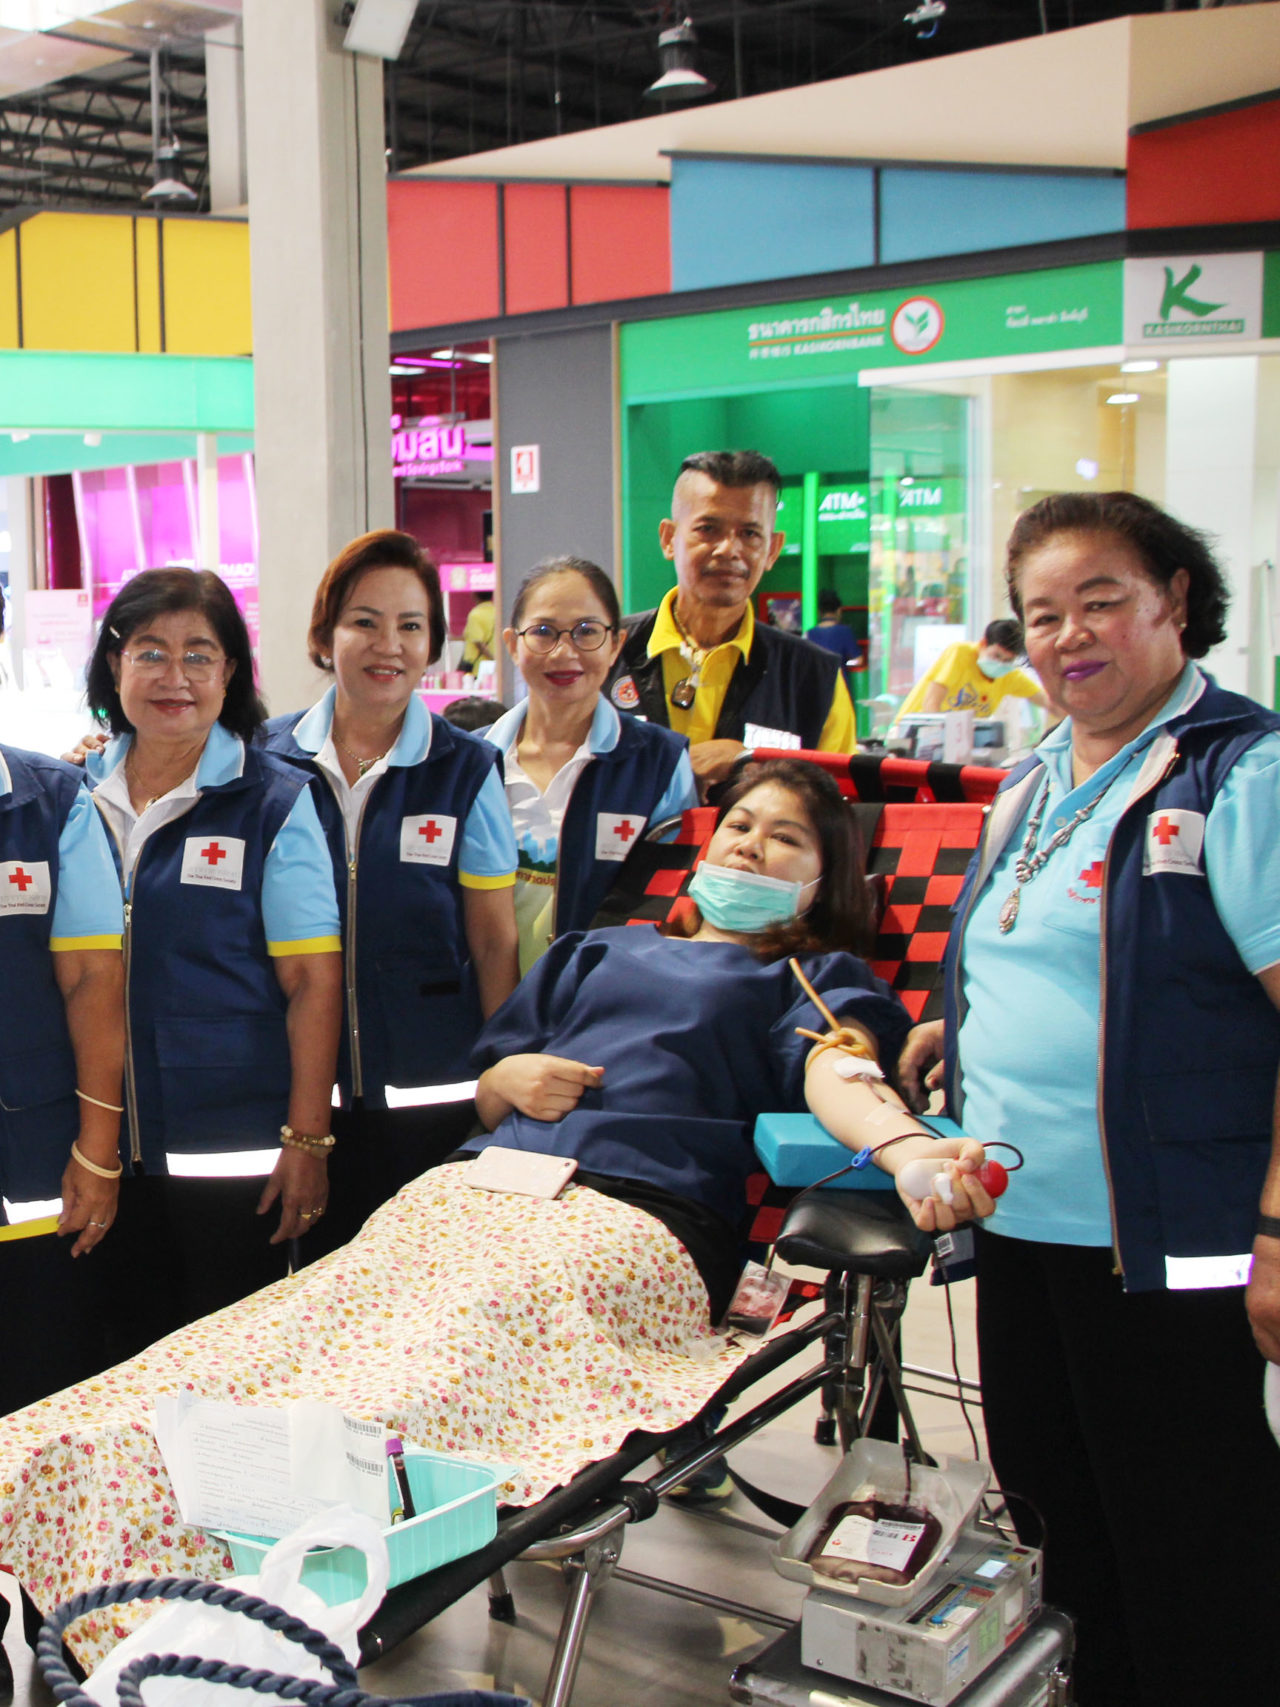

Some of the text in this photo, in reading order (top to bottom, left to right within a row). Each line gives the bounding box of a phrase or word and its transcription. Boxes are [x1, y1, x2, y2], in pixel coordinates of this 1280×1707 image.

[748, 302, 886, 340] ธนาคารกสิกรไทย
